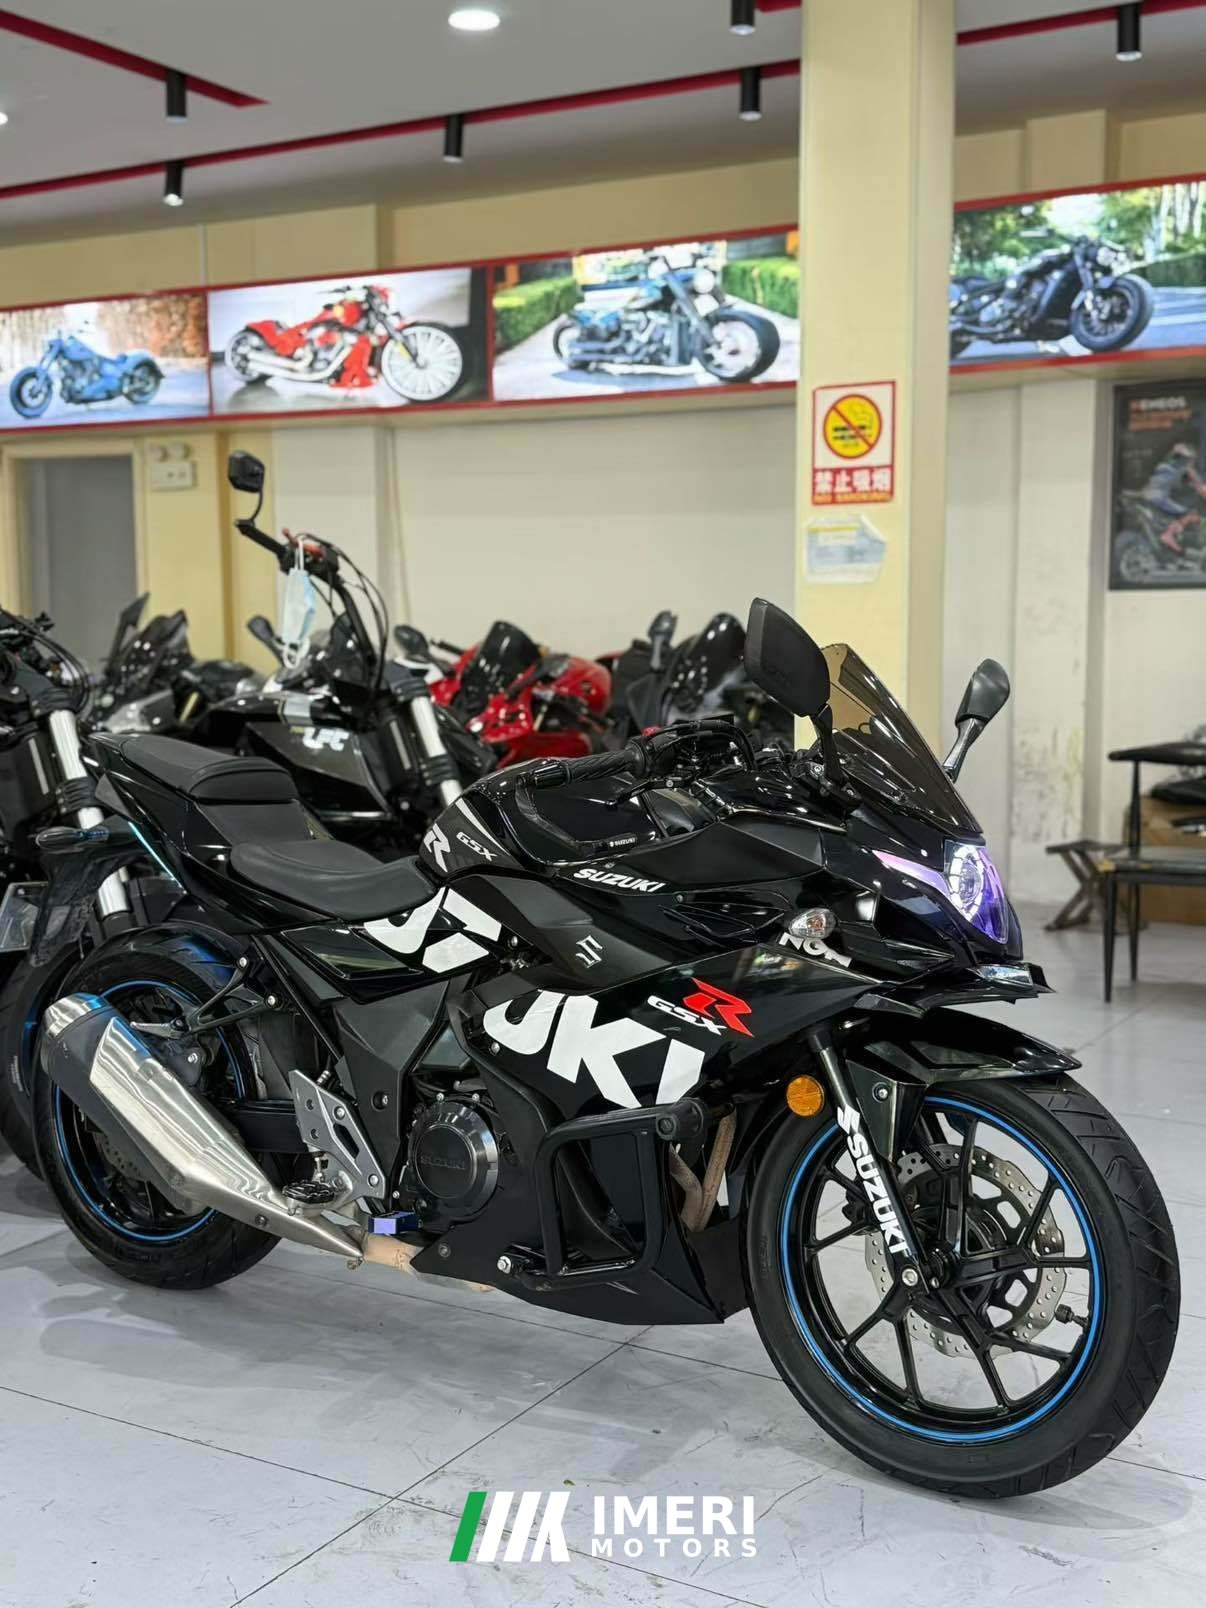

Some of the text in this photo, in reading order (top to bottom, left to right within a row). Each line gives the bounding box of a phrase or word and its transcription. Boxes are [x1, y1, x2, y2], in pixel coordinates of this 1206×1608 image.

[456, 831, 498, 862] GSX
[573, 868, 667, 893] SUZUKI
[647, 977, 754, 1037] GSX R
[847, 1132, 911, 1258] SUZUKI
